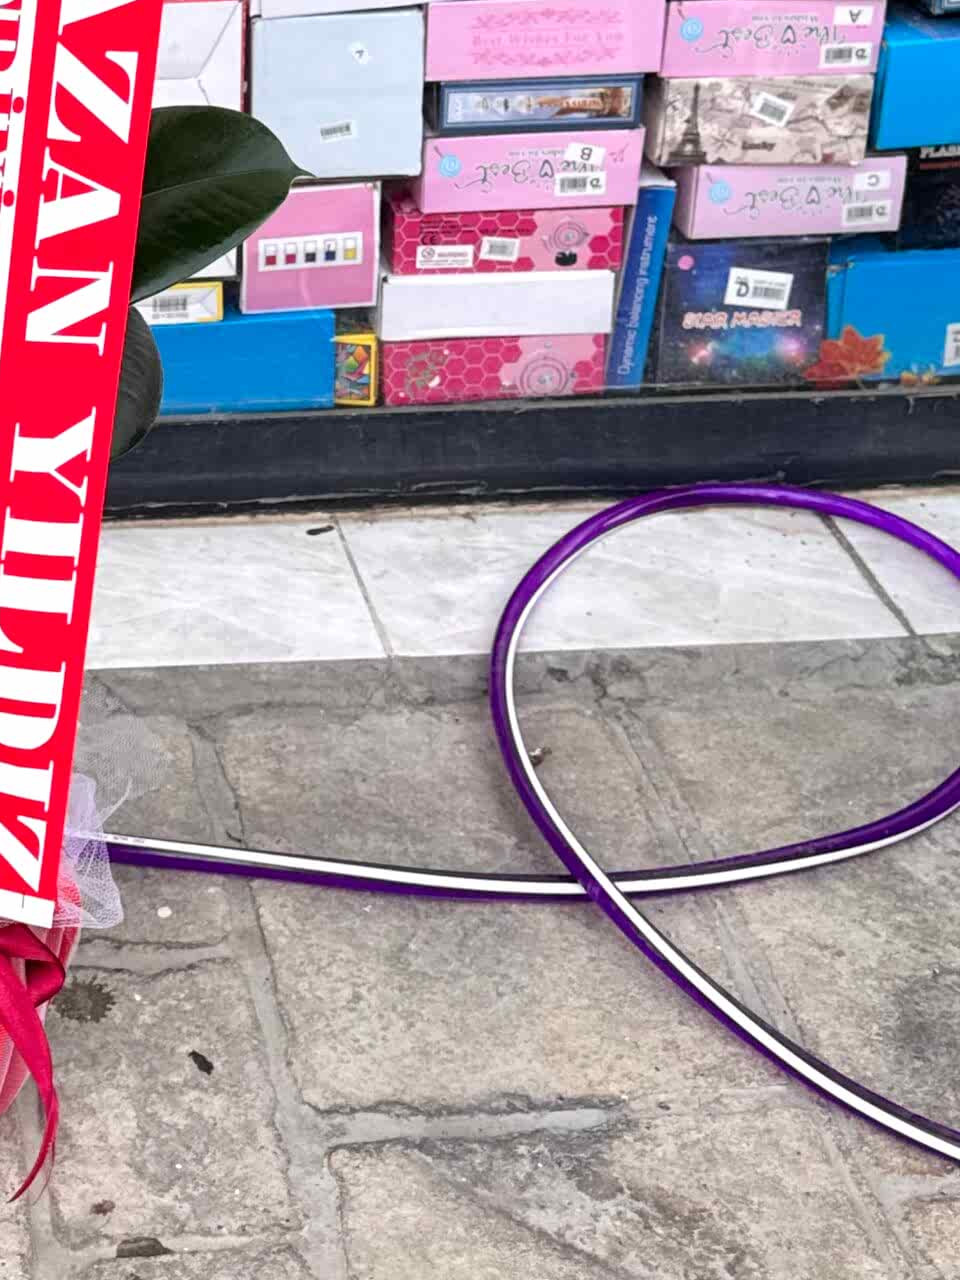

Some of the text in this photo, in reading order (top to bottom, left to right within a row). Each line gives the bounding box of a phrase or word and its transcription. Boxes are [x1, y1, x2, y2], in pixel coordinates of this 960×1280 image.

[848, 9, 862, 23] A
[580, 147, 593, 161] B
[617, 215, 658, 376] Dynamic balancing instrument
